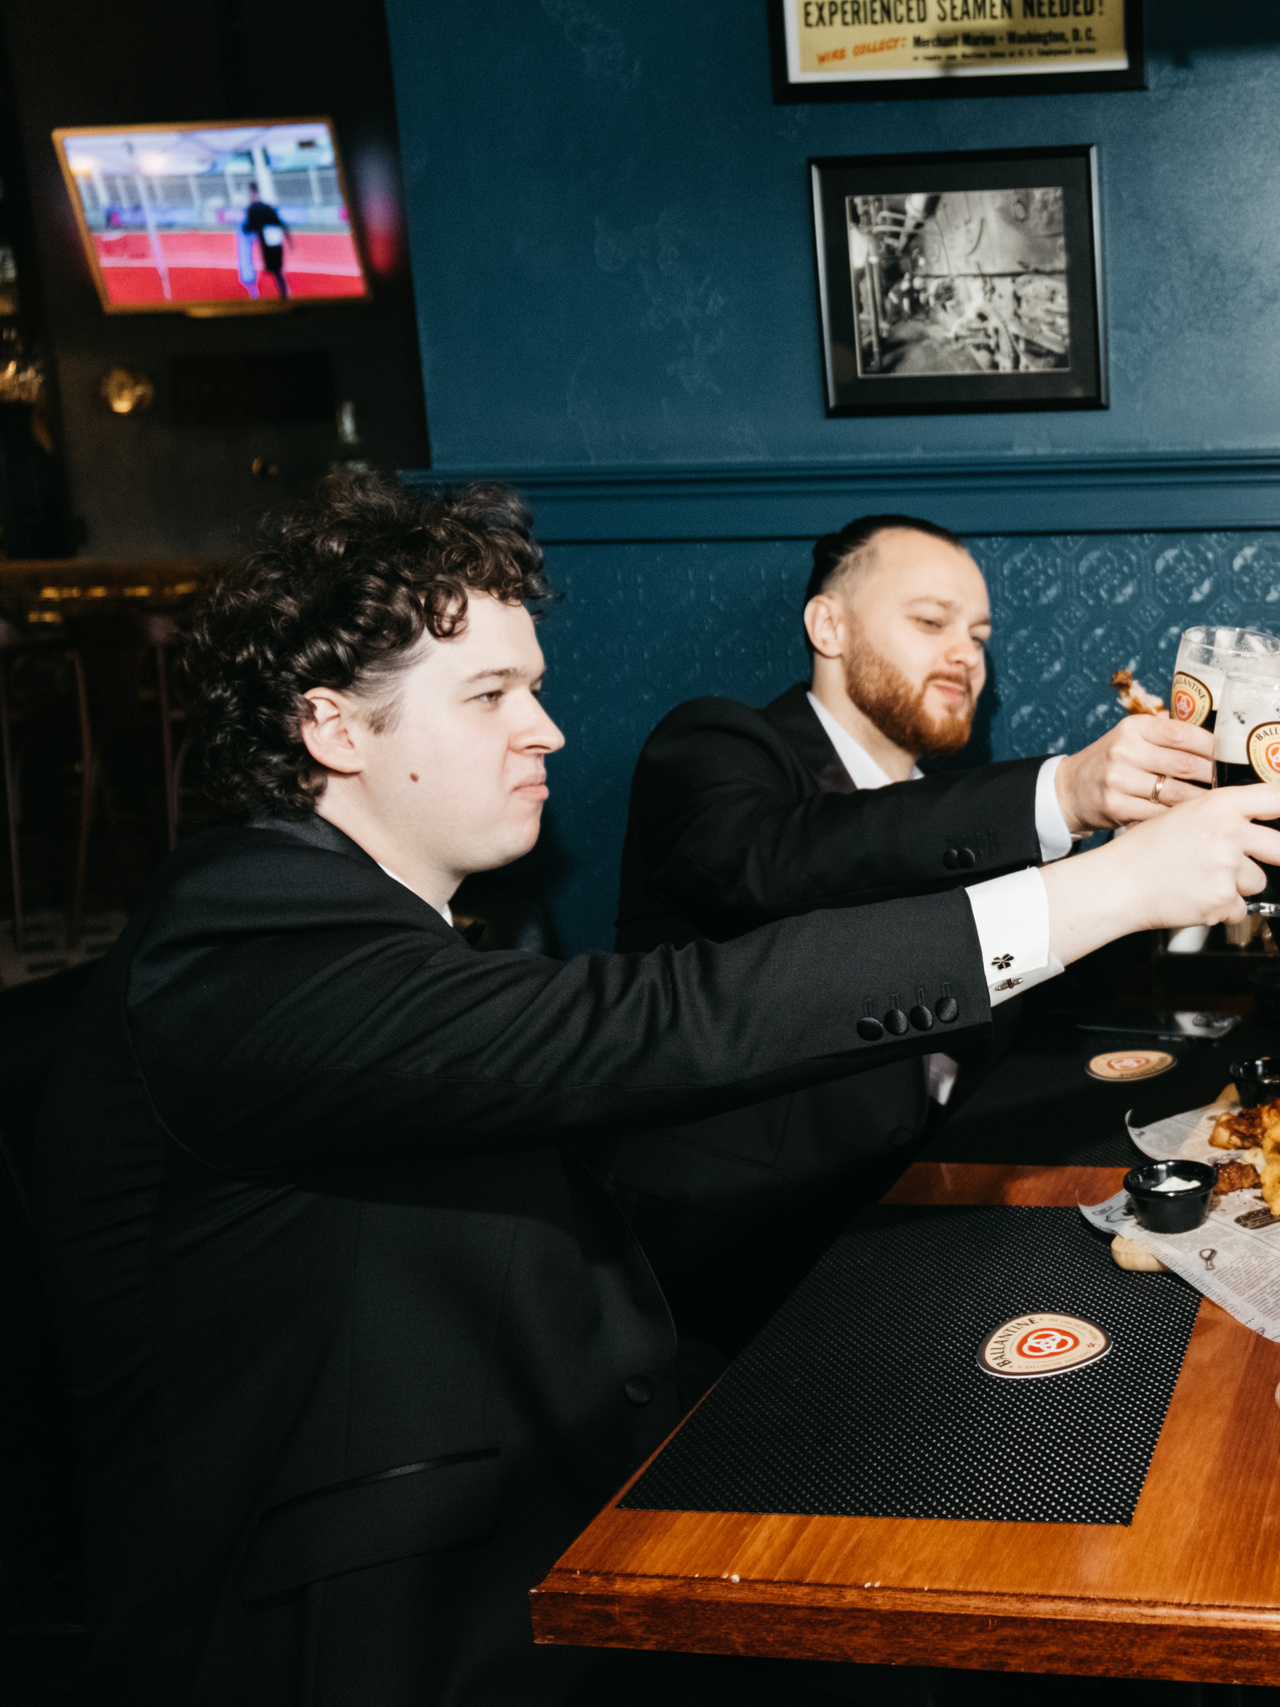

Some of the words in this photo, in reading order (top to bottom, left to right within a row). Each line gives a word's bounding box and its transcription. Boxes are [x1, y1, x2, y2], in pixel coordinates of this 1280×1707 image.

[804, 0, 927, 27] EXPERIENCED
[937, 0, 1012, 21] SEAMEN
[912, 34, 958, 48] Merchant
[962, 32, 996, 46] Marine
[816, 47, 847, 64] WIRE
[1173, 676, 1206, 700] ALLANTINE
[990, 1317, 1040, 1367] BALLANTINE
